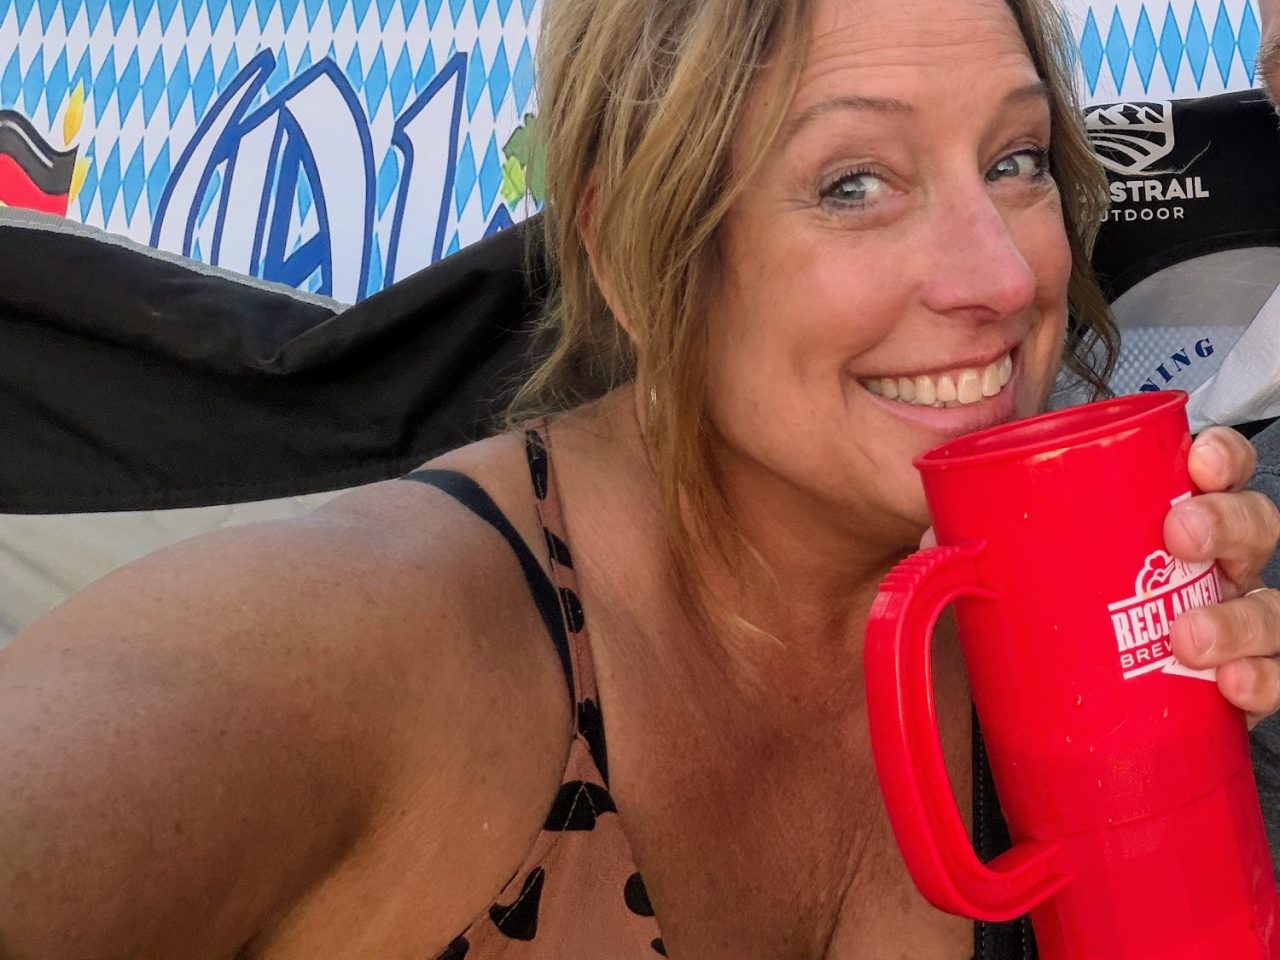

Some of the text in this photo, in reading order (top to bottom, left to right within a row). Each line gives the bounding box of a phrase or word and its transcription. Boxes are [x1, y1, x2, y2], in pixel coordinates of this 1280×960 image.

[1108, 176, 1210, 203] STRAIL
[1100, 206, 1185, 222] UTDOOR
[1120, 640, 1173, 669] BRE
